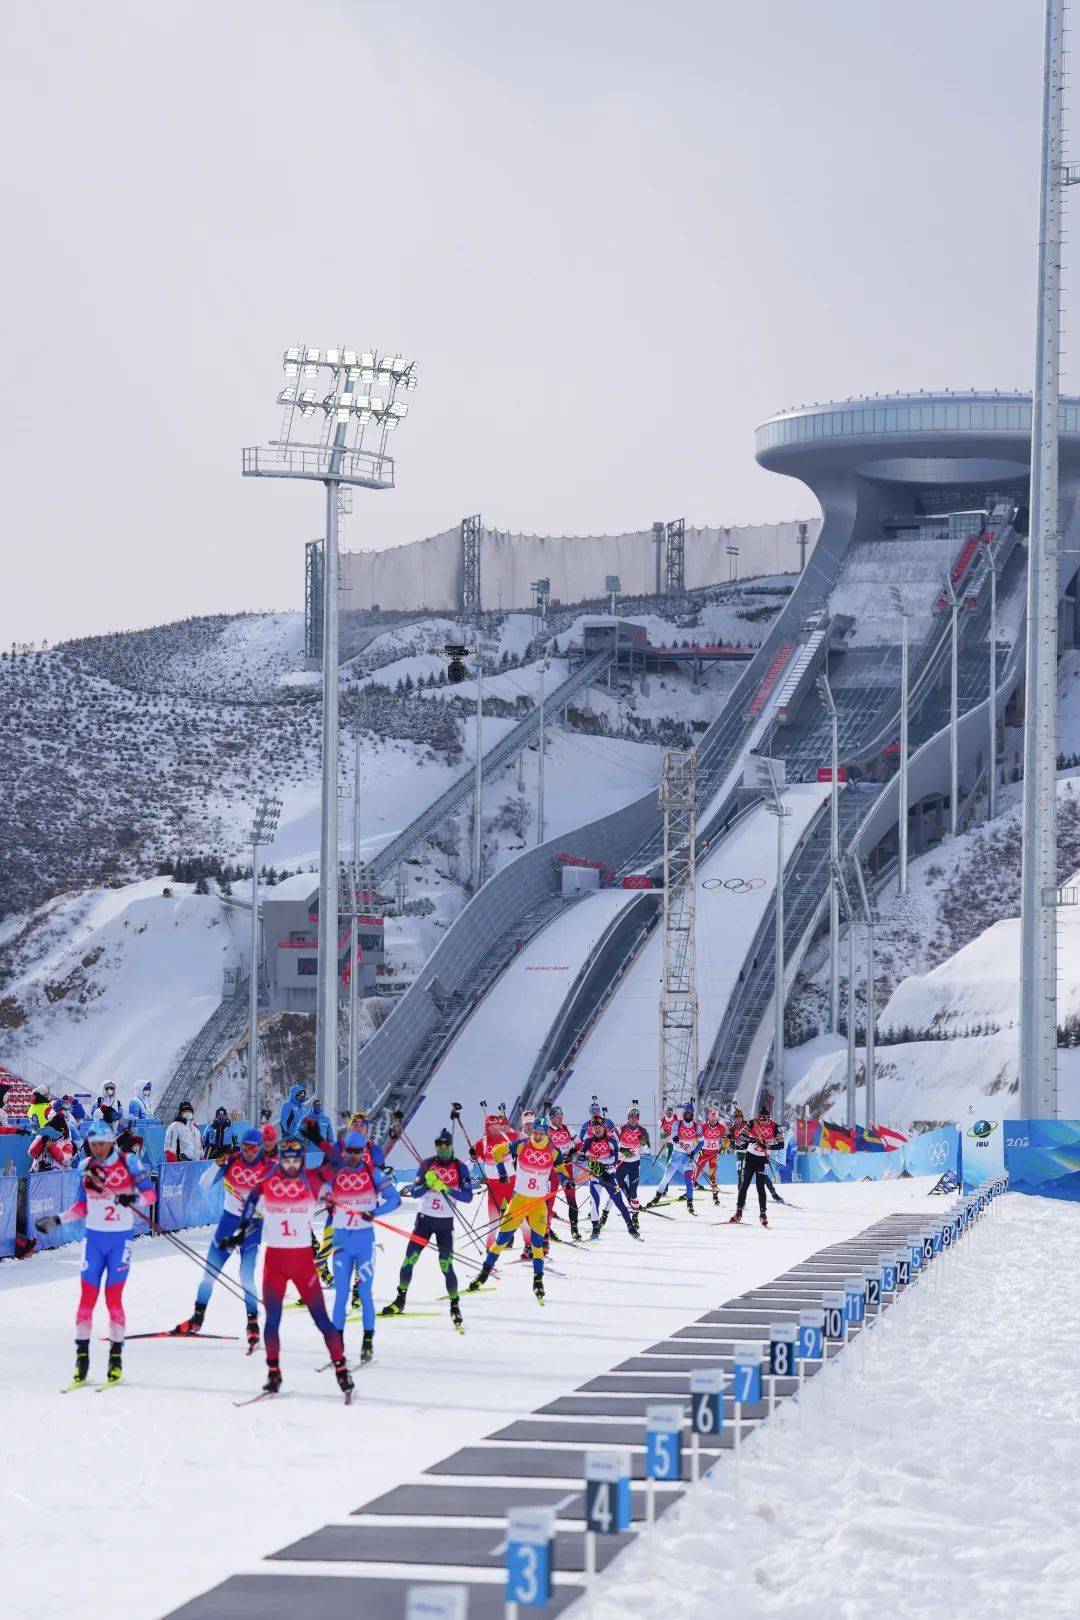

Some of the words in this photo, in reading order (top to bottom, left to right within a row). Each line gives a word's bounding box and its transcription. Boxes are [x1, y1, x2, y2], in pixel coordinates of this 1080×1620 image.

[528, 1178, 537, 1190] 8
[104, 1206, 116, 1222] 2
[431, 1200, 441, 1210] 5
[281, 1220, 292, 1236] 1
[881, 1267, 894, 1290] 13
[896, 1262, 908, 1284] 14
[865, 1280, 879, 1304] 12
[847, 1295, 860, 1320] 11
[823, 1308, 841, 1337] 10
[804, 1328, 815, 1357] 9
[774, 1342, 788, 1375] 8
[740, 1367, 753, 1401] 7
[697, 1394, 713, 1433] 6
[653, 1434, 670, 1477] 5
[591, 1483, 612, 1532] 4
[516, 1546, 537, 1604] 3
